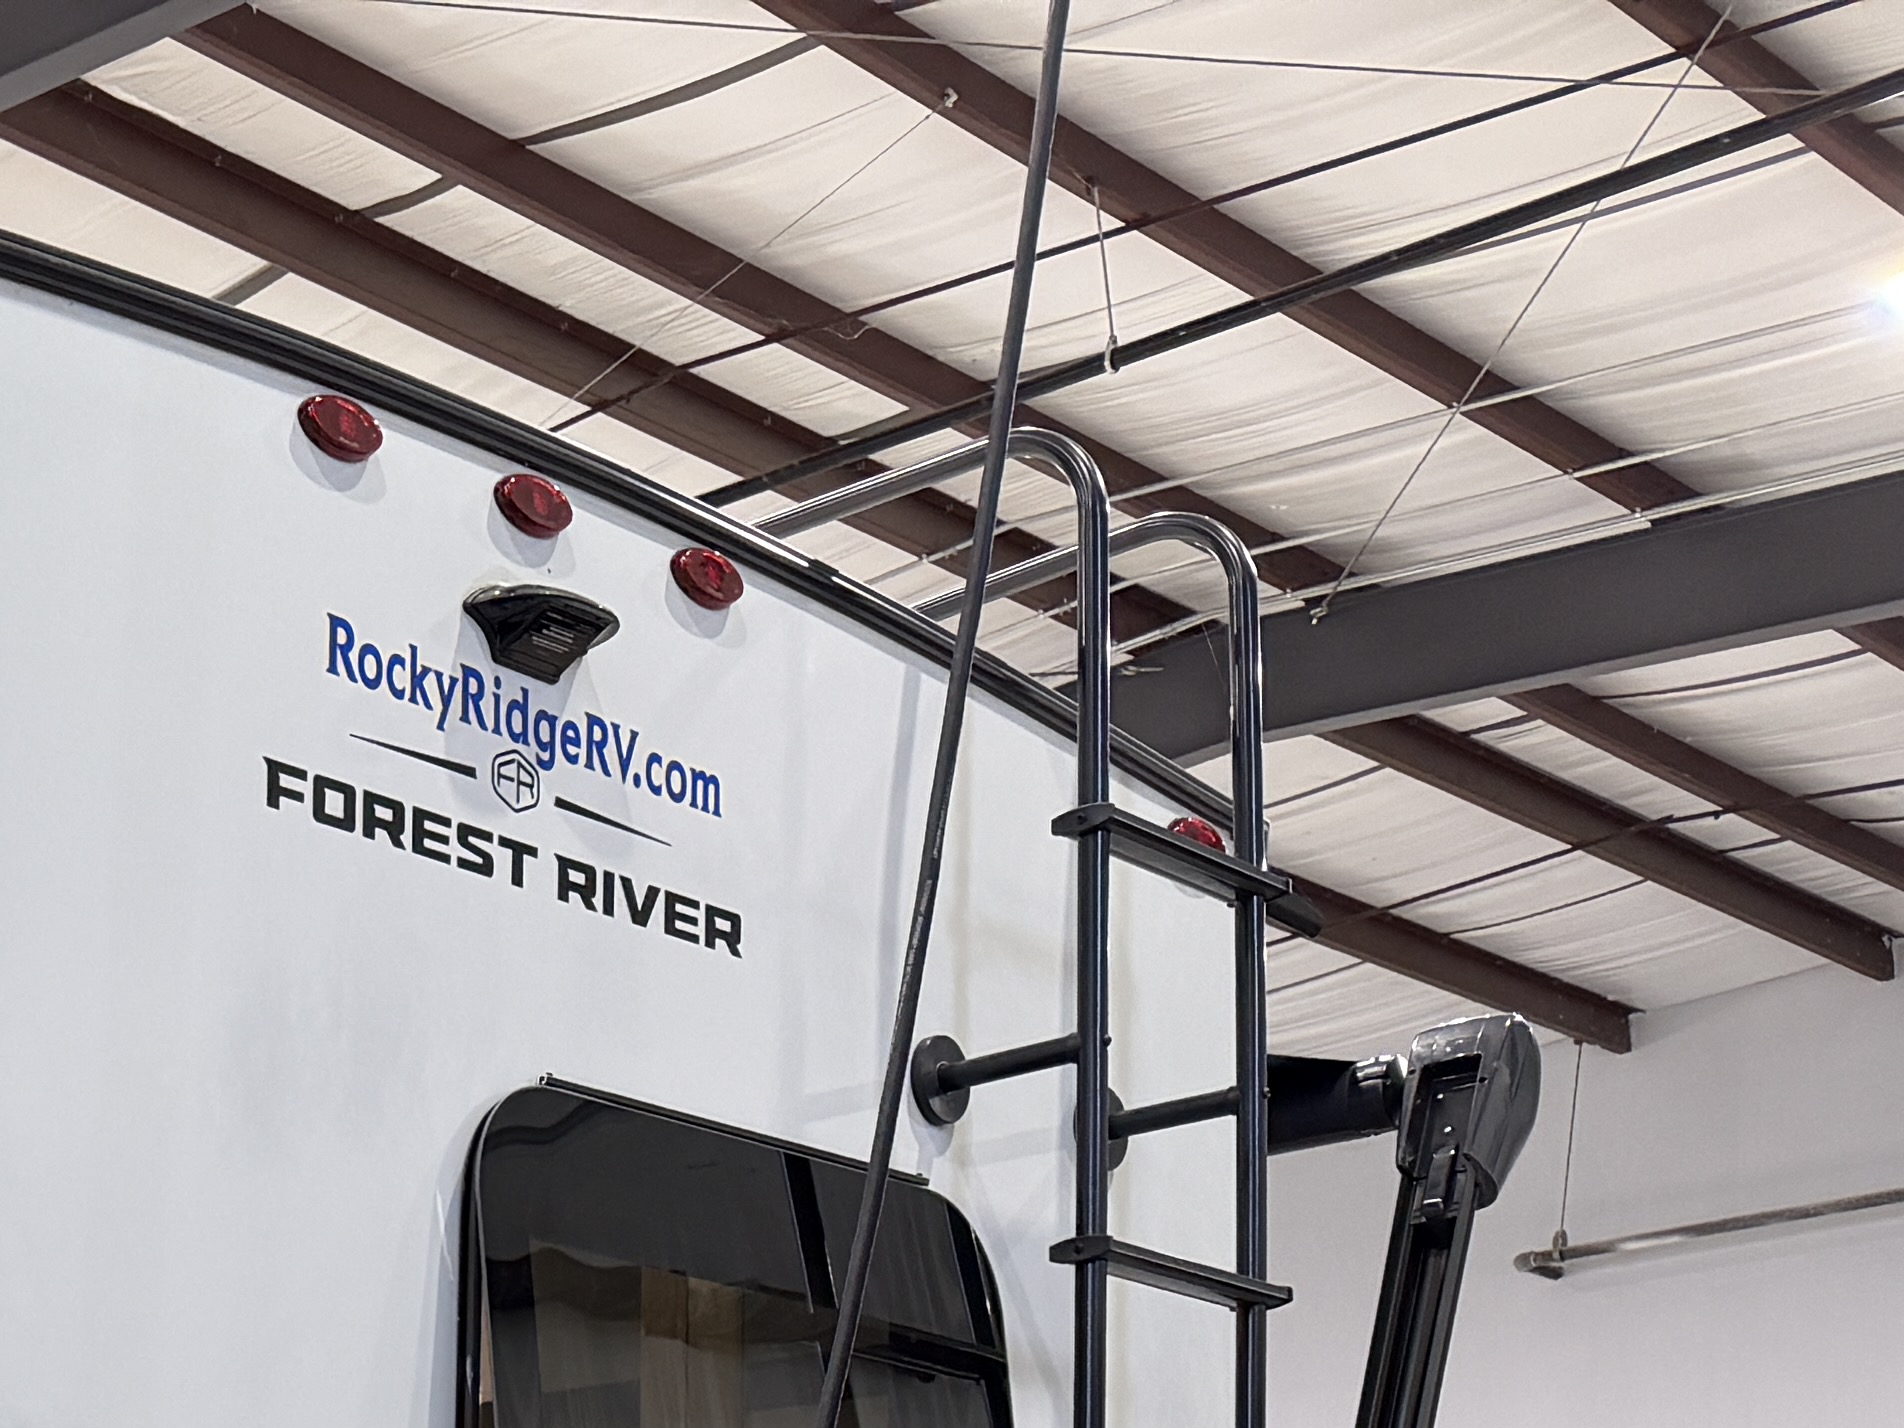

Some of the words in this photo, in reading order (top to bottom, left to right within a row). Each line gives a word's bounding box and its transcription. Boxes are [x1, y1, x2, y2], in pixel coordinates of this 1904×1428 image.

[326, 612, 722, 818] RockyRidgeRV.com
[262, 755, 539, 888] FOREST
[553, 852, 742, 959] RIVER
